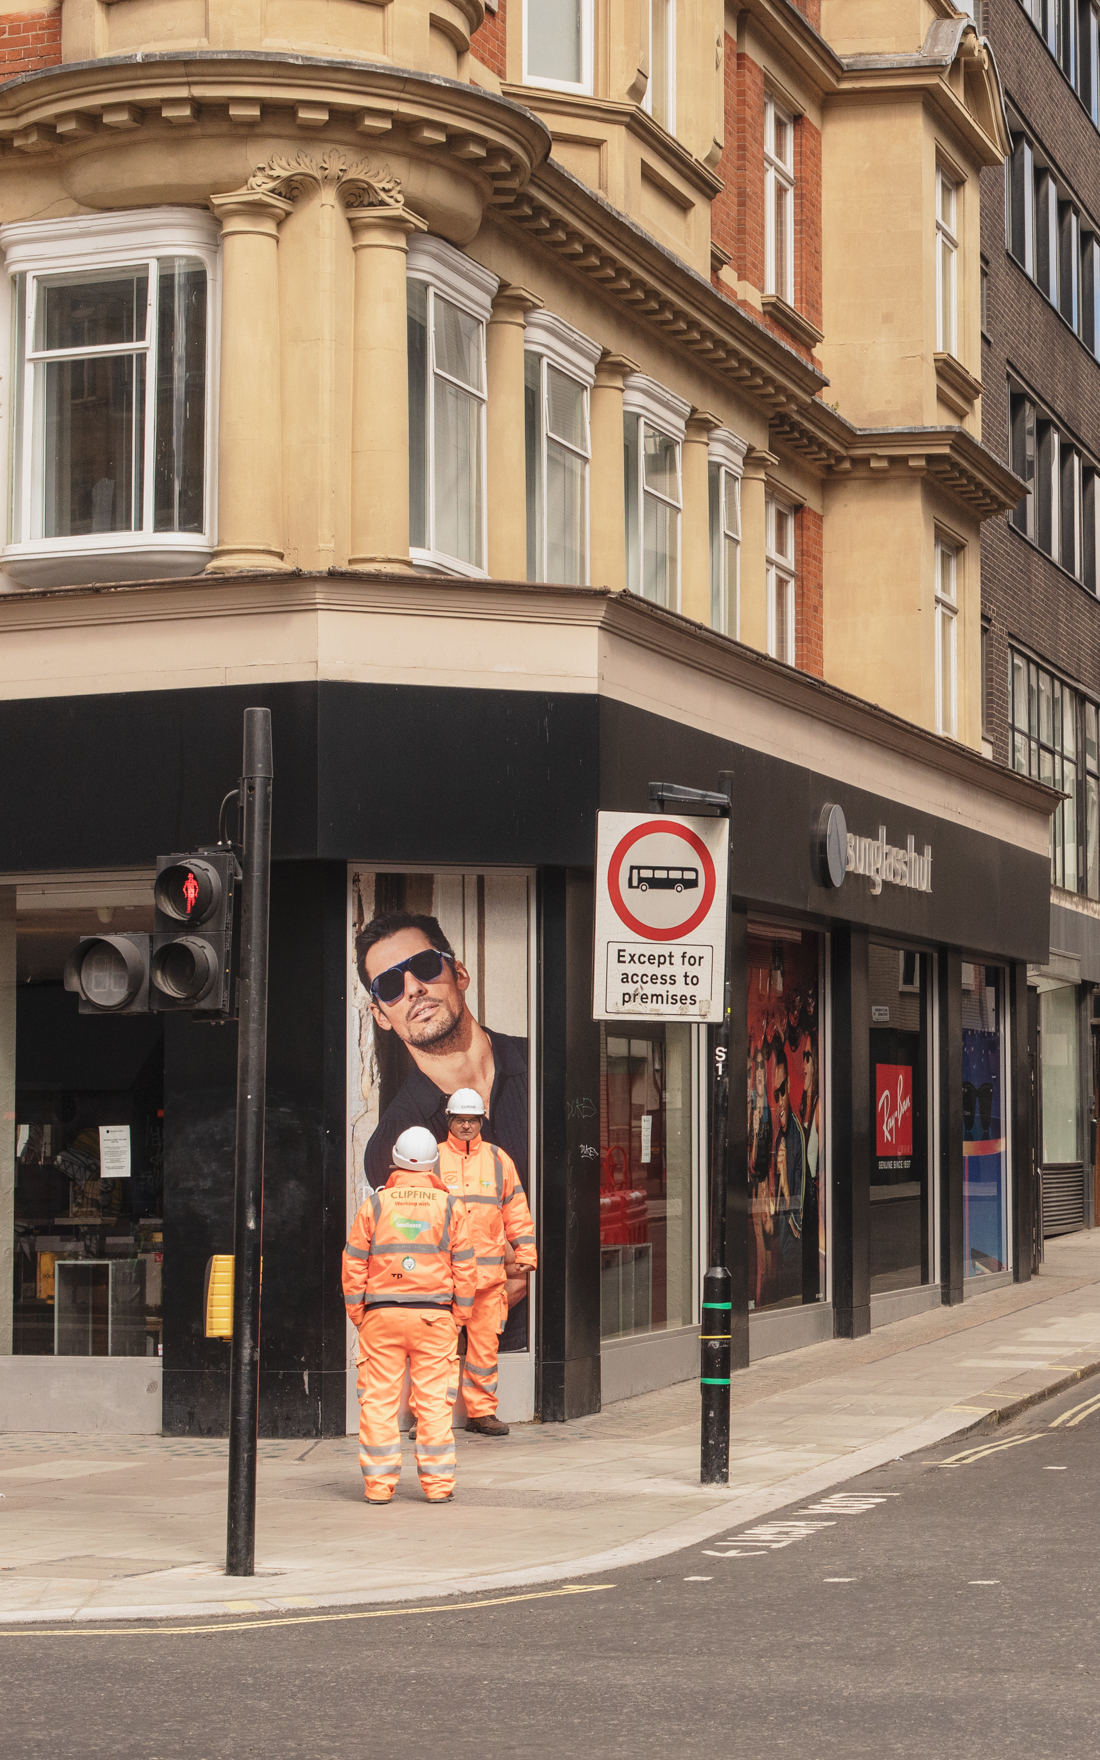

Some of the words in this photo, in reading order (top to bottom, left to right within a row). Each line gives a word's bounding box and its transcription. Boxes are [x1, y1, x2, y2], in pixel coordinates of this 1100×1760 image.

[617, 949, 674, 968] Except
[681, 952, 704, 966] for
[620, 972, 677, 985] access
[683, 971, 700, 986] to
[622, 990, 697, 1006] premises
[390, 1190, 437, 1201] CLIPFINE
[788, 1492, 901, 1515] LOOK
